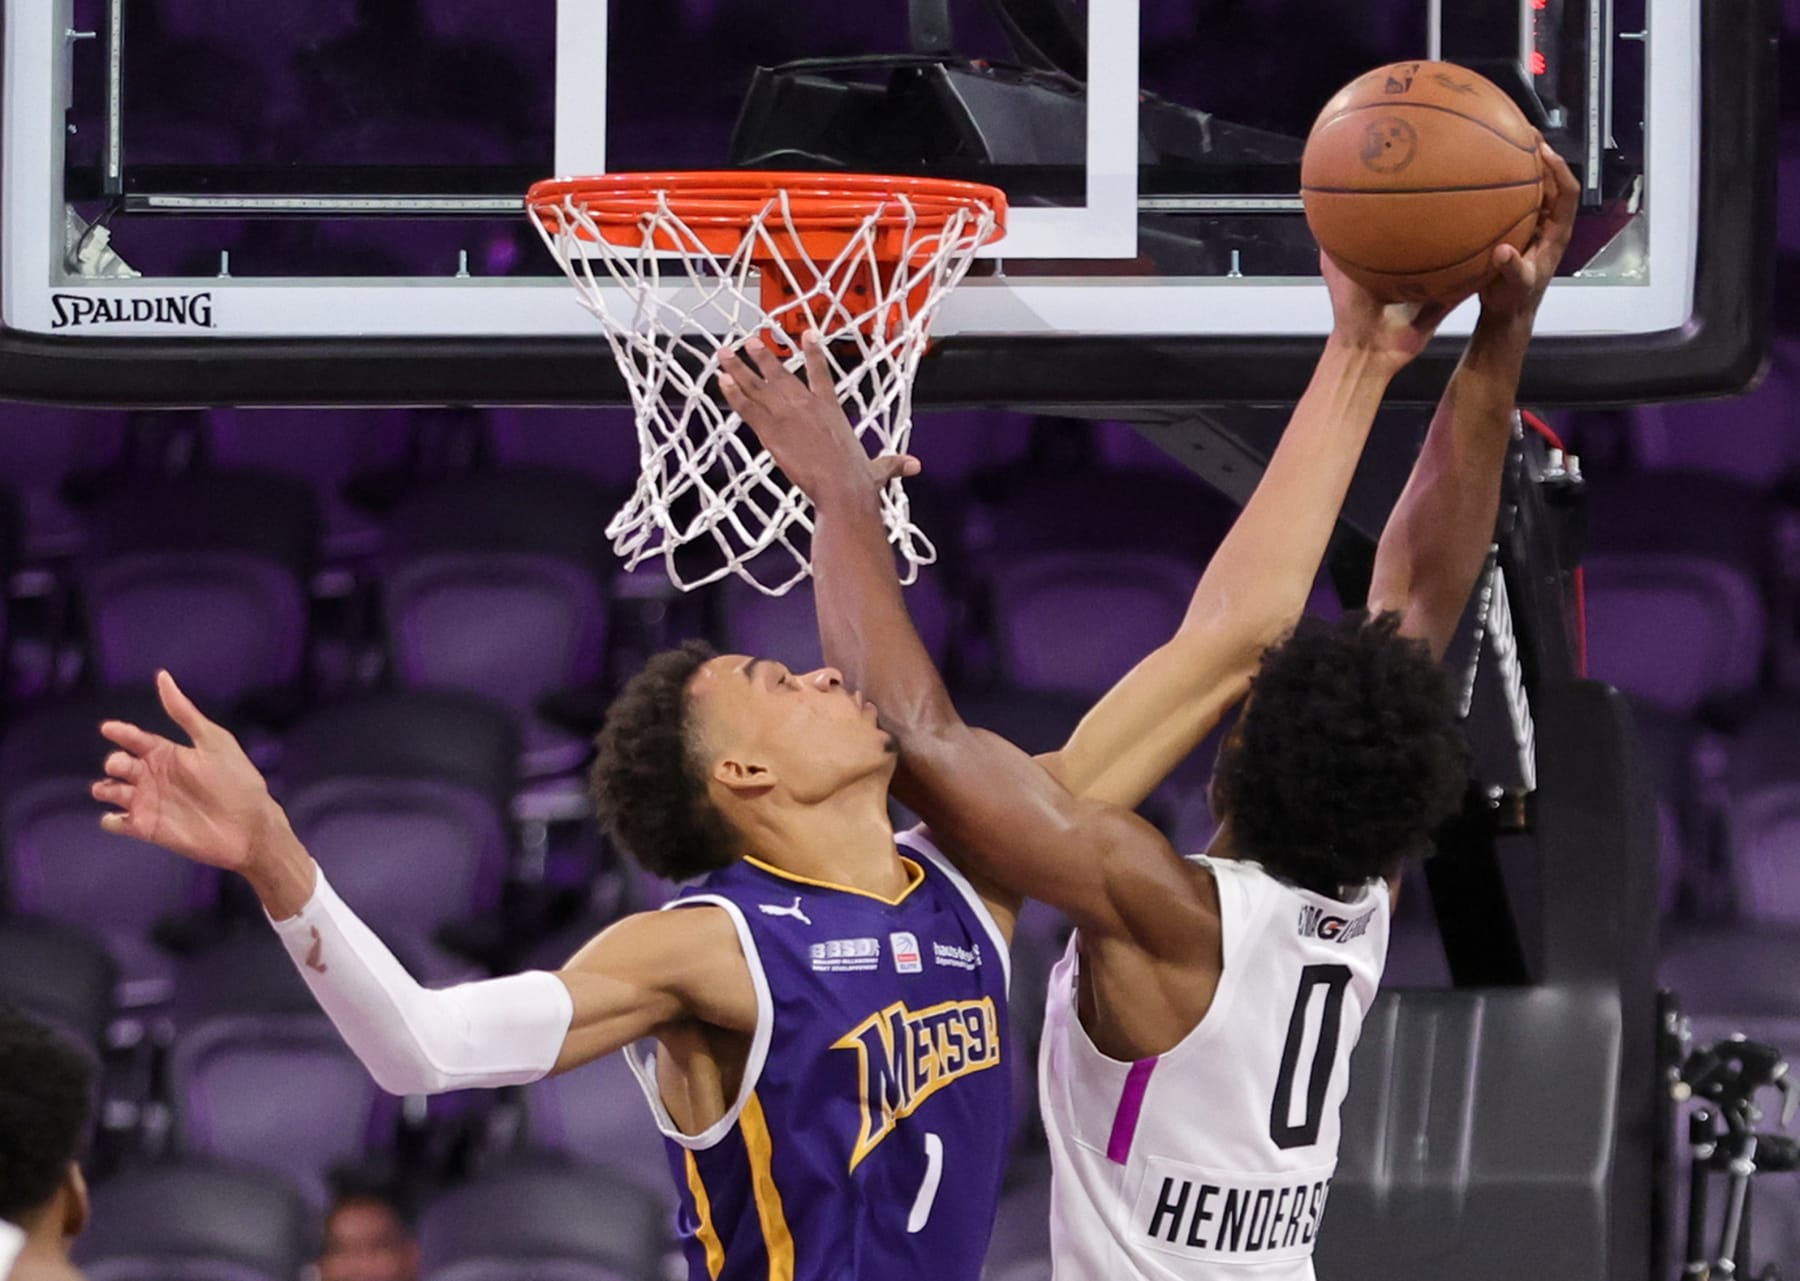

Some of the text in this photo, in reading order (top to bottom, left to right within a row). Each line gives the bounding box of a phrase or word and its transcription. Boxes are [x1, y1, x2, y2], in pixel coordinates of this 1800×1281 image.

[51, 292, 212, 329] SPALDING
[1270, 963, 1352, 1150] 0
[907, 1132, 943, 1233] 1
[1147, 1176, 1332, 1253] HENDERS
